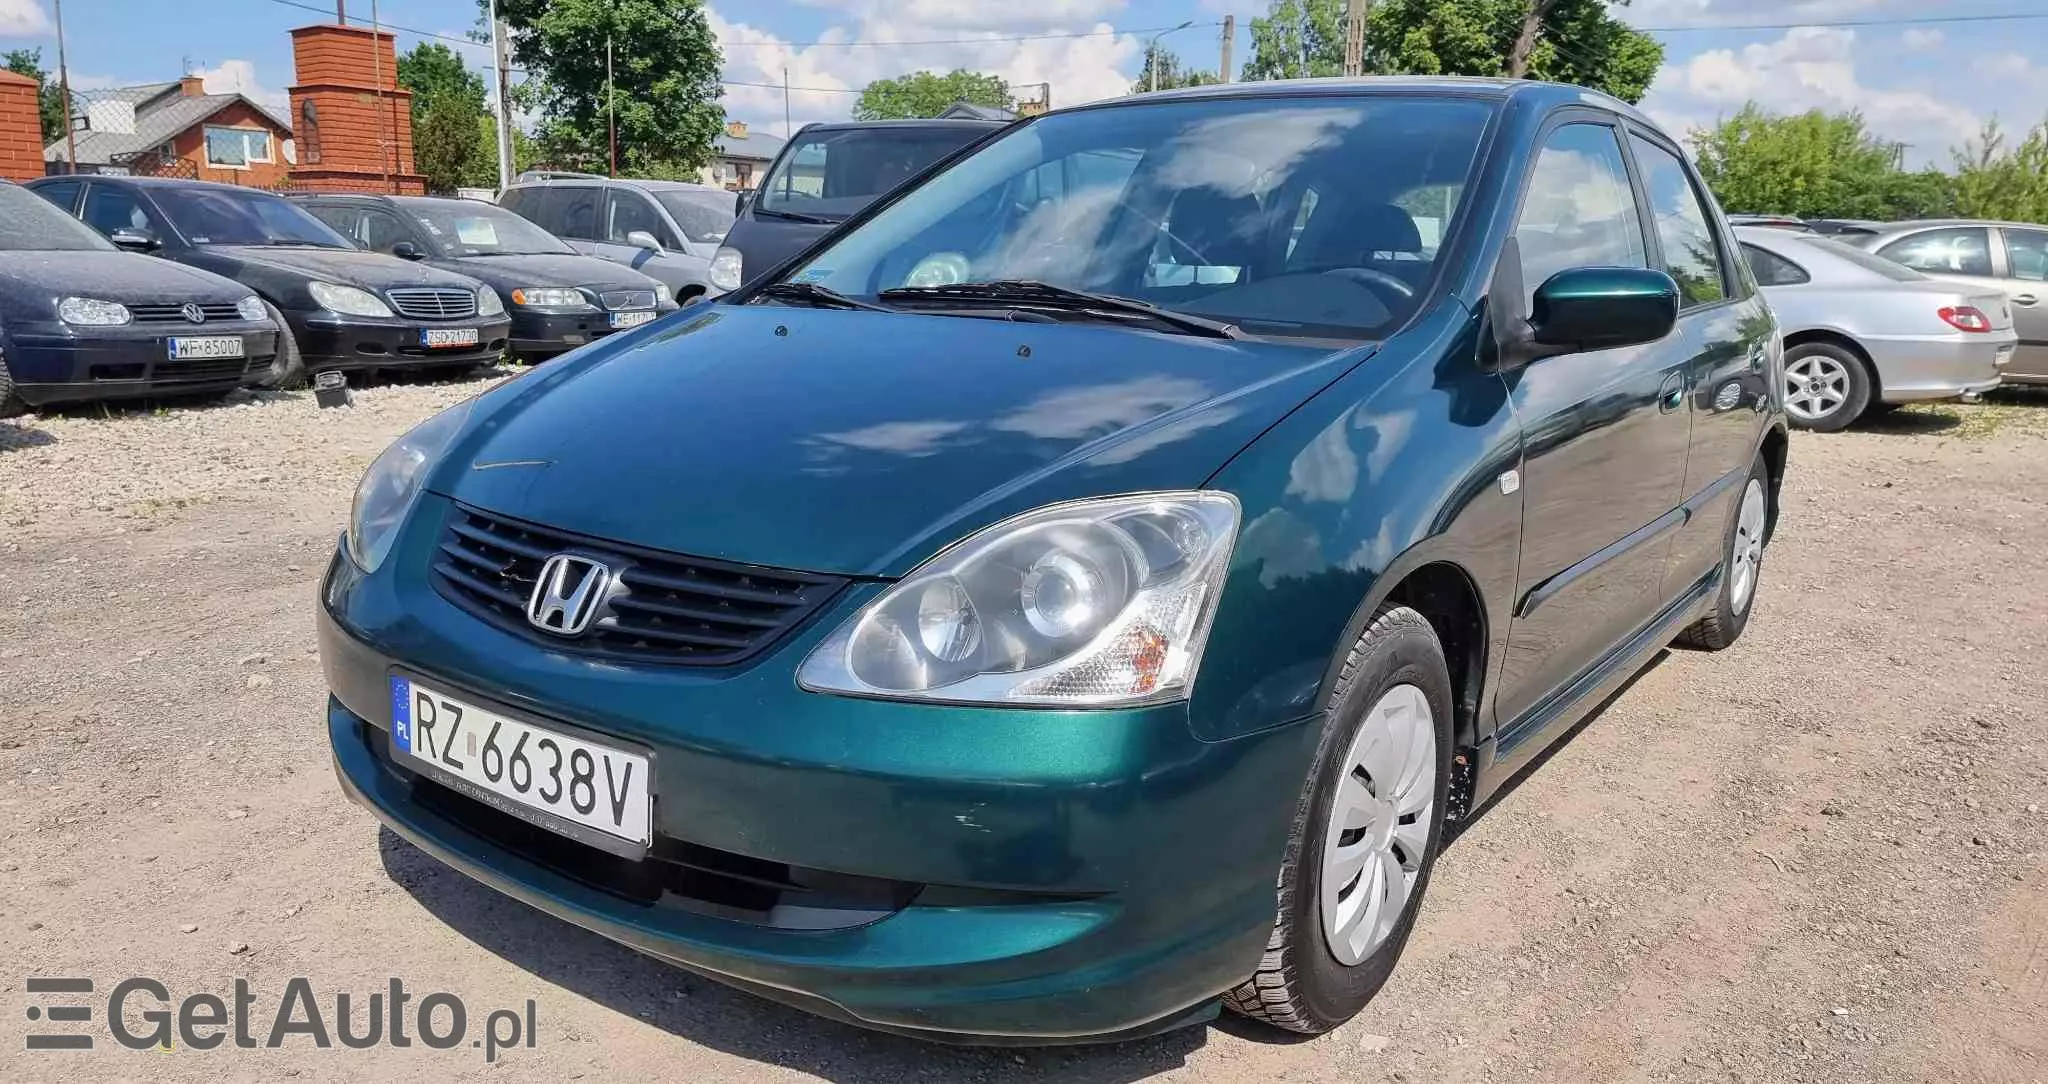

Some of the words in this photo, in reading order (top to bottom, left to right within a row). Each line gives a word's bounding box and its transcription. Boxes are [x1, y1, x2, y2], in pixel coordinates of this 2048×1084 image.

[179, 340, 199, 355] WF
[204, 339, 240, 354] 85007
[397, 720, 409, 741] PL
[416, 692, 464, 771] RZ
[481, 721, 633, 827] 6638V
